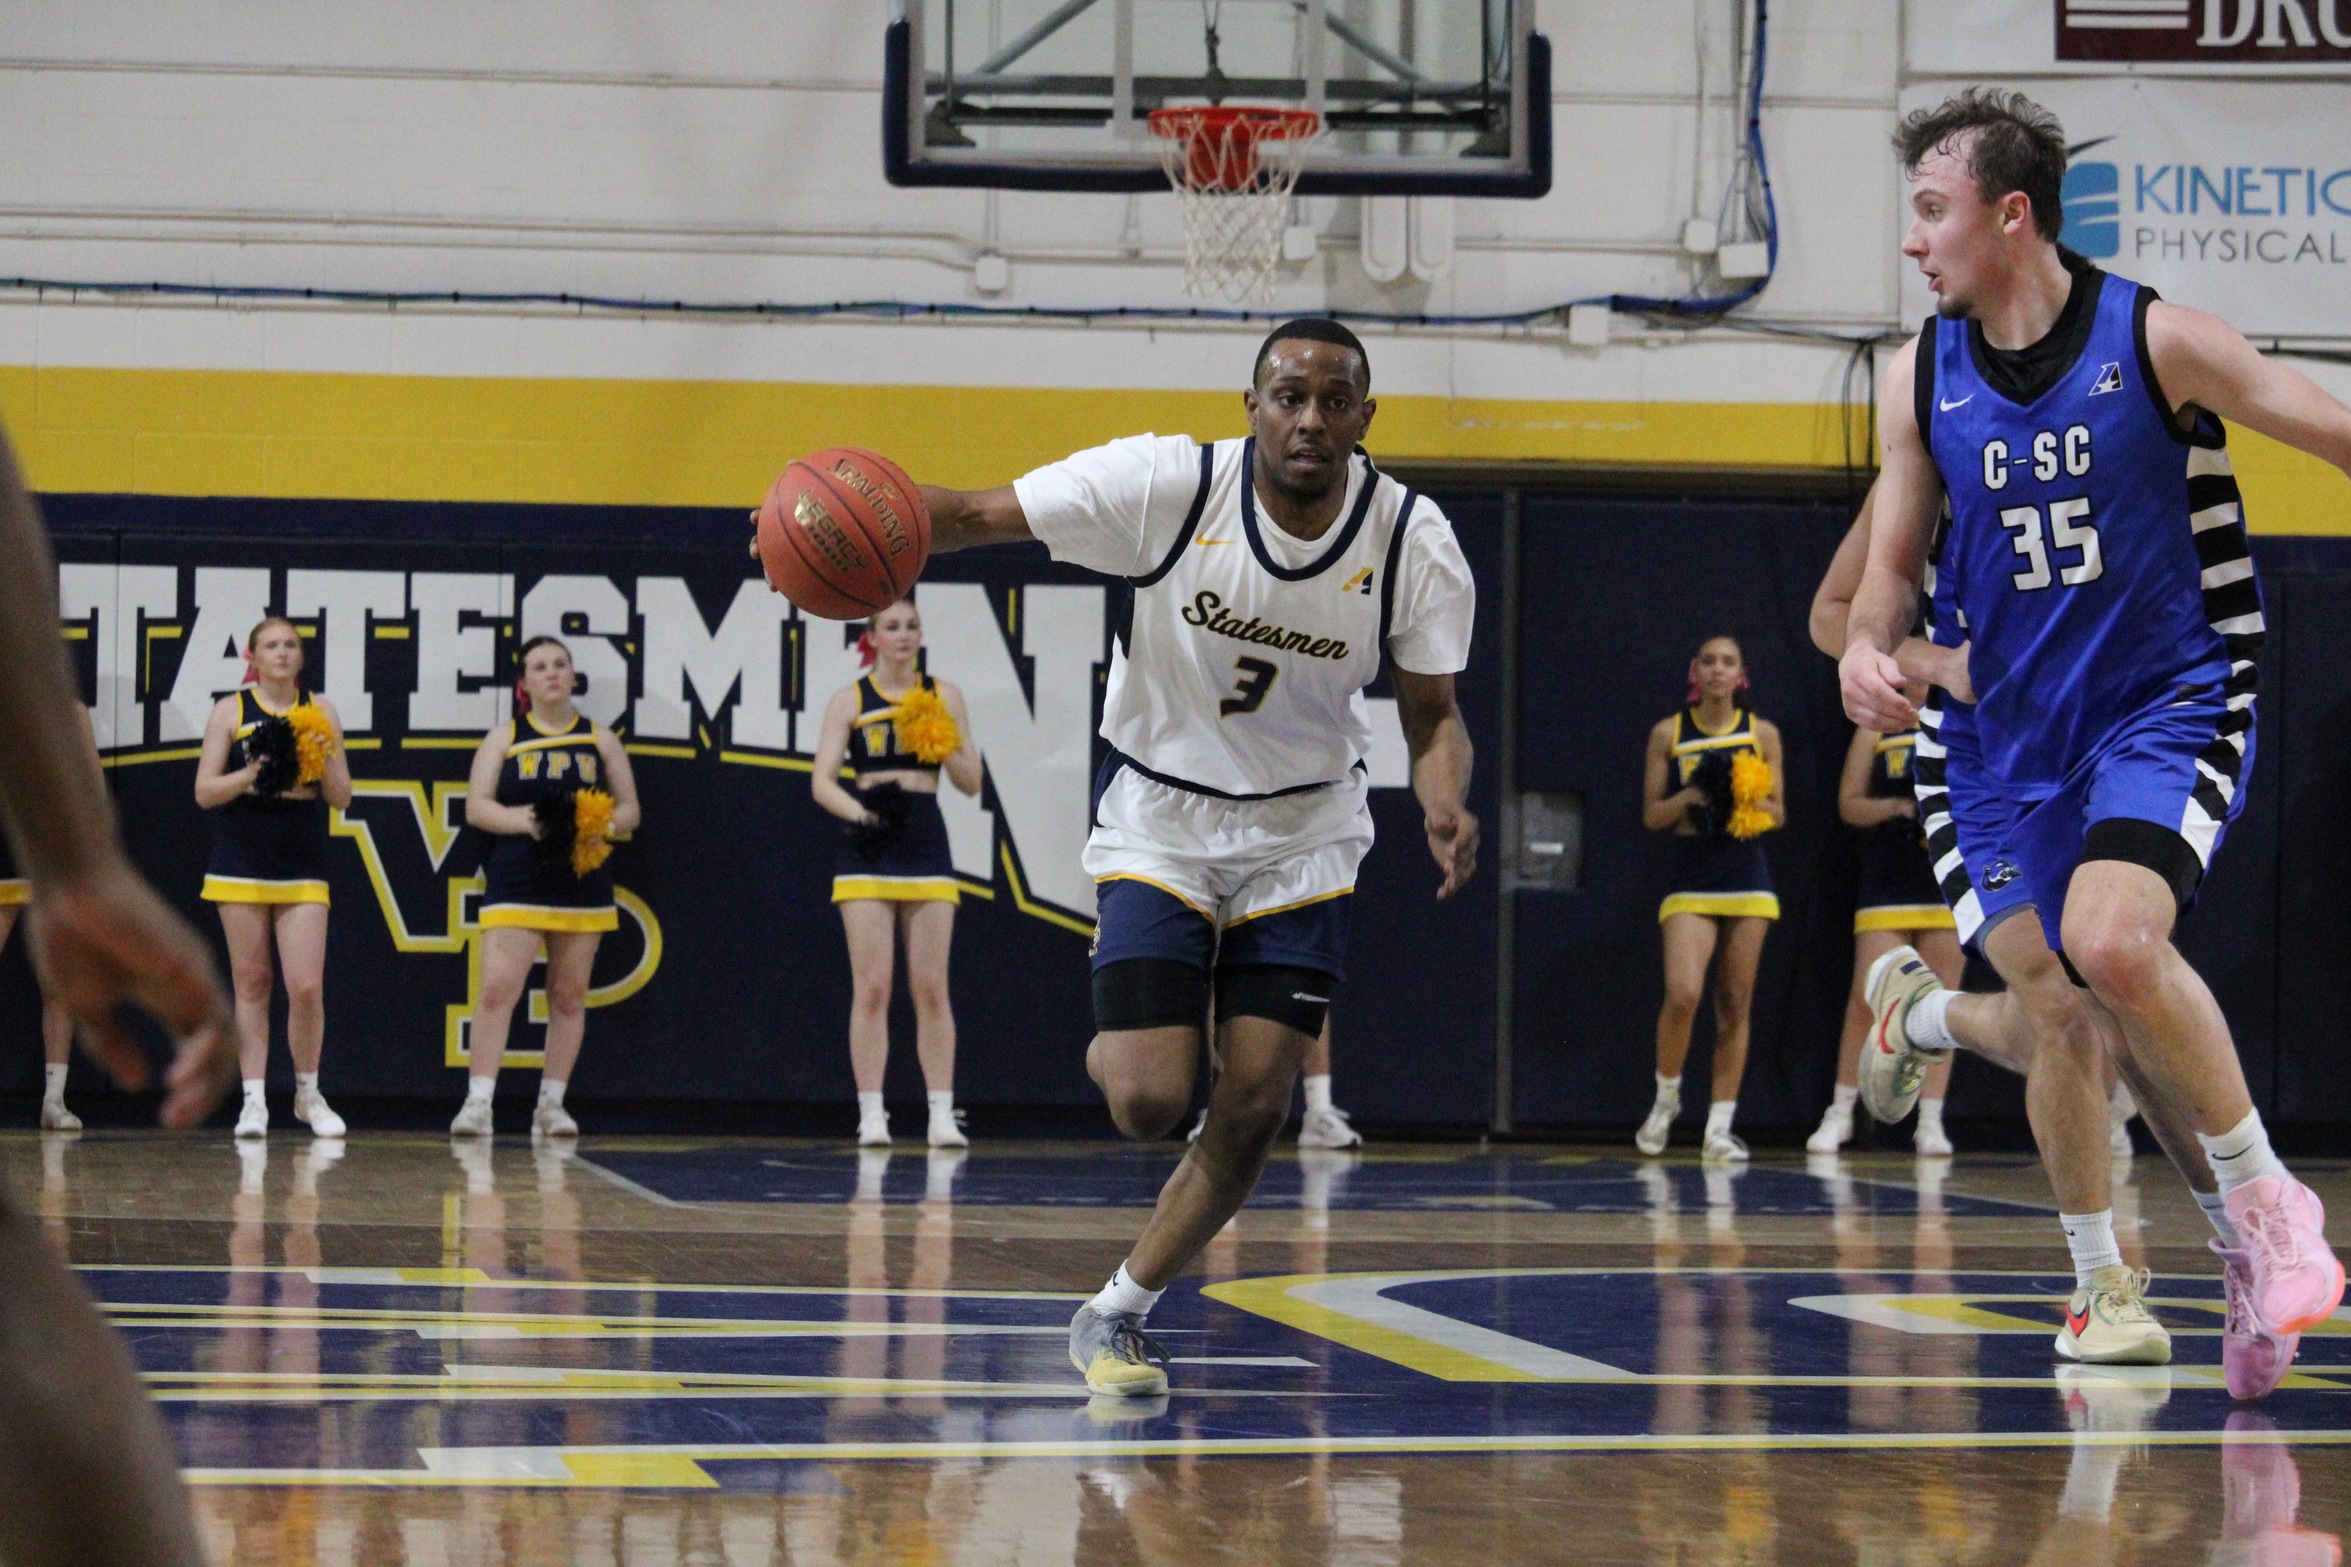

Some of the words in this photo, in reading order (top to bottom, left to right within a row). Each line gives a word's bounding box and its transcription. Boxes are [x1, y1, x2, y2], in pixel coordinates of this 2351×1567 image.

[2135, 227, 2346, 264] PHYSICAL
[1982, 424, 2091, 491] C-SC
[797, 487, 870, 573] LEGACY
[825, 458, 910, 558] SPALDING
[1999, 497, 2104, 591] 35
[1181, 590, 1349, 660] Statesmen
[1218, 655, 1280, 720] 3
[516, 751, 598, 784] WPU
